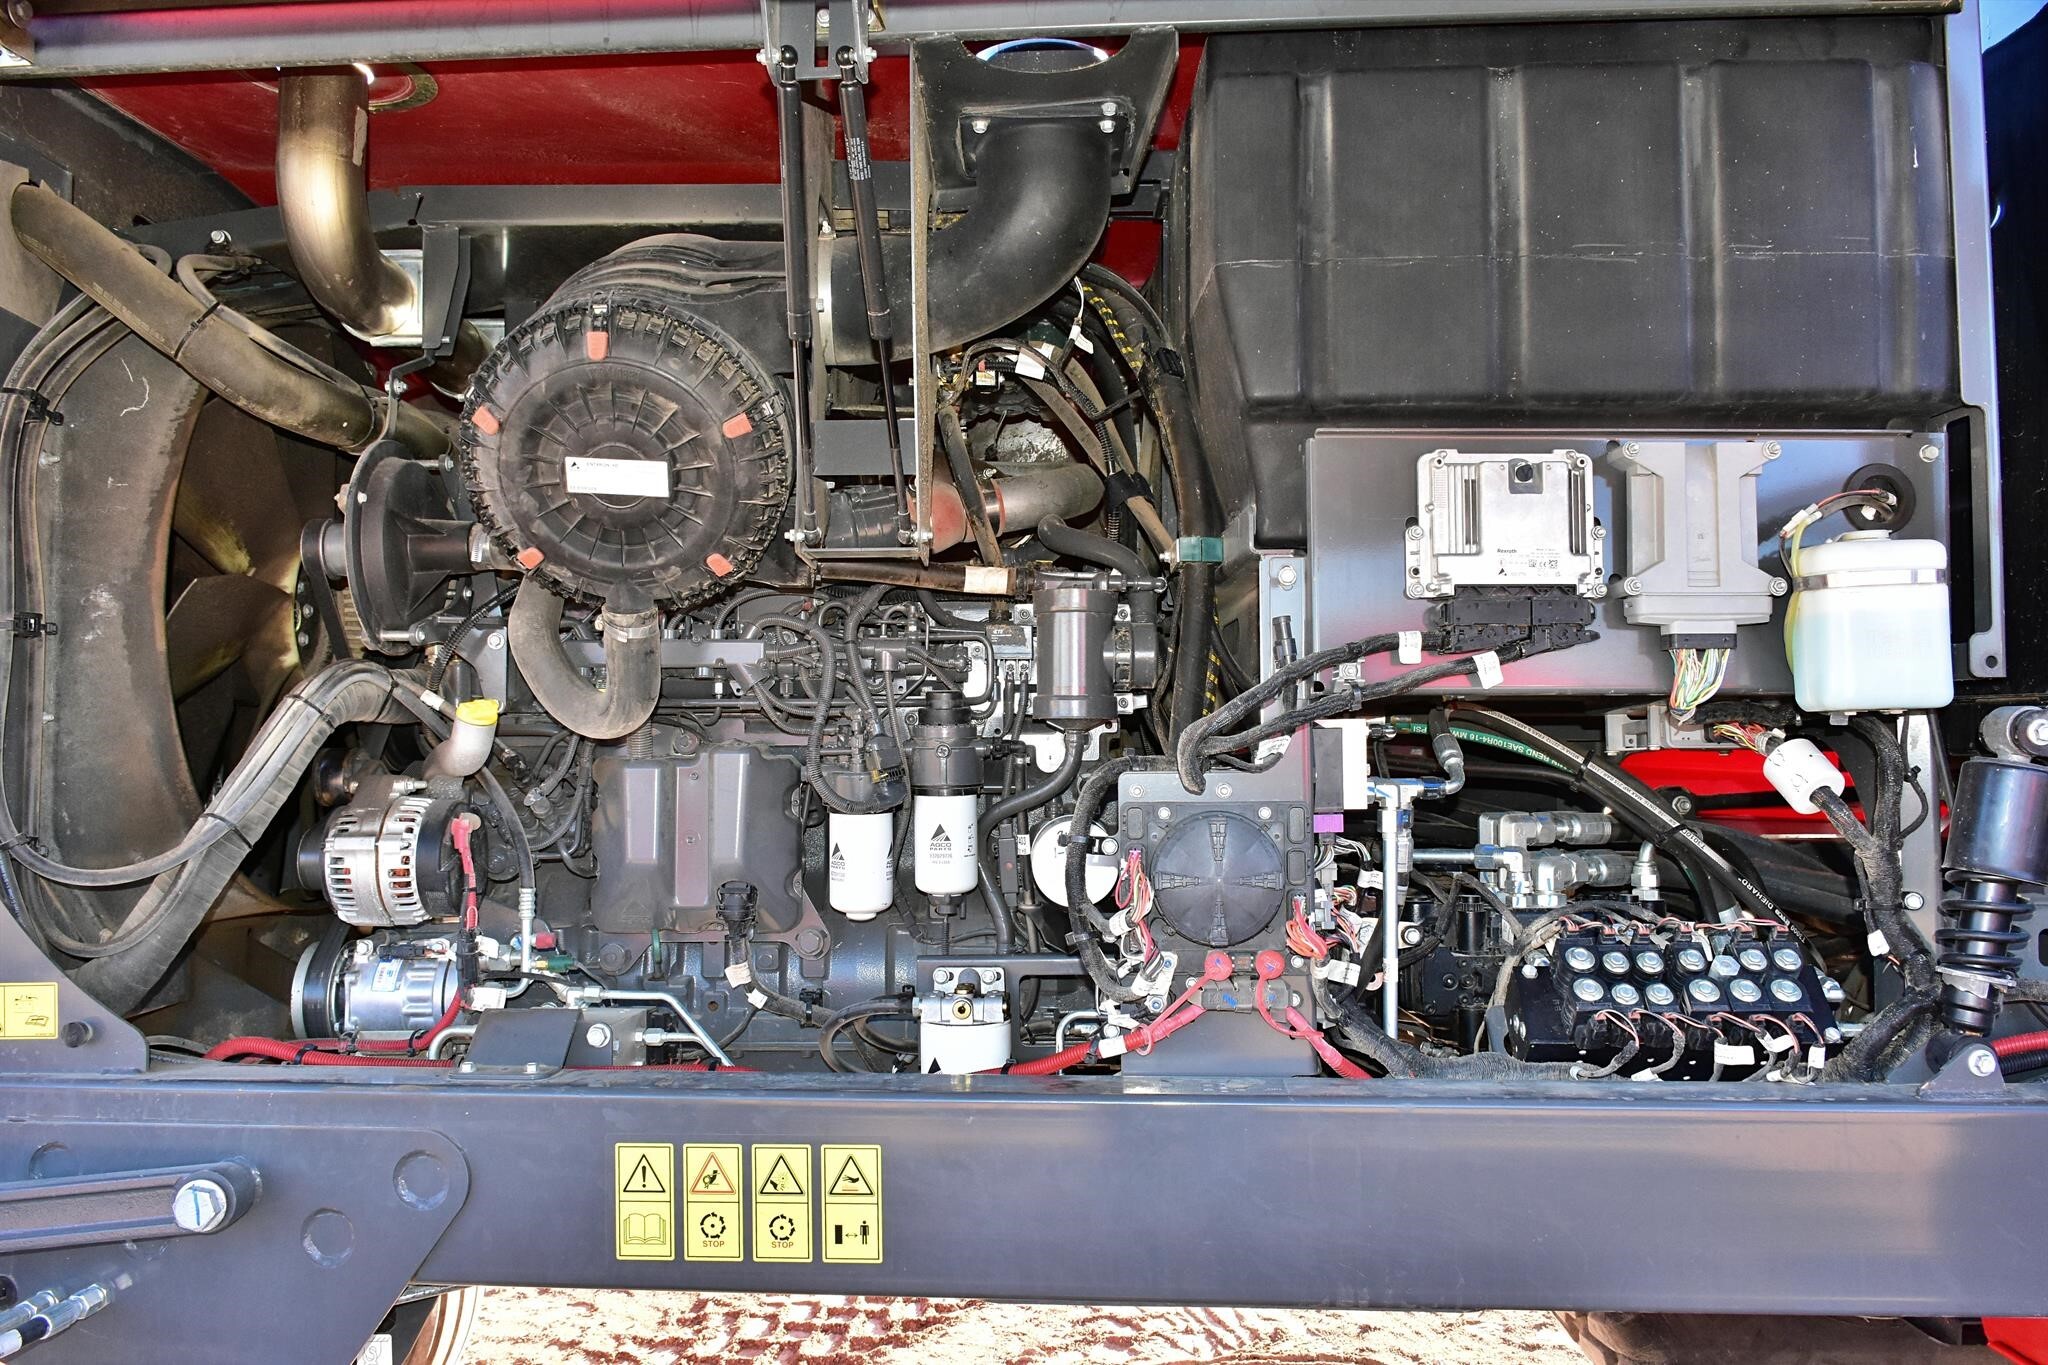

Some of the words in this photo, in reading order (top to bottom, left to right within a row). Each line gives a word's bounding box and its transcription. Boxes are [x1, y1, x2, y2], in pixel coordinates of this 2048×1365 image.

[1412, 724, 1427, 733] PSI
[702, 1240, 725, 1248] STOP
[771, 1241, 794, 1249] STOP
